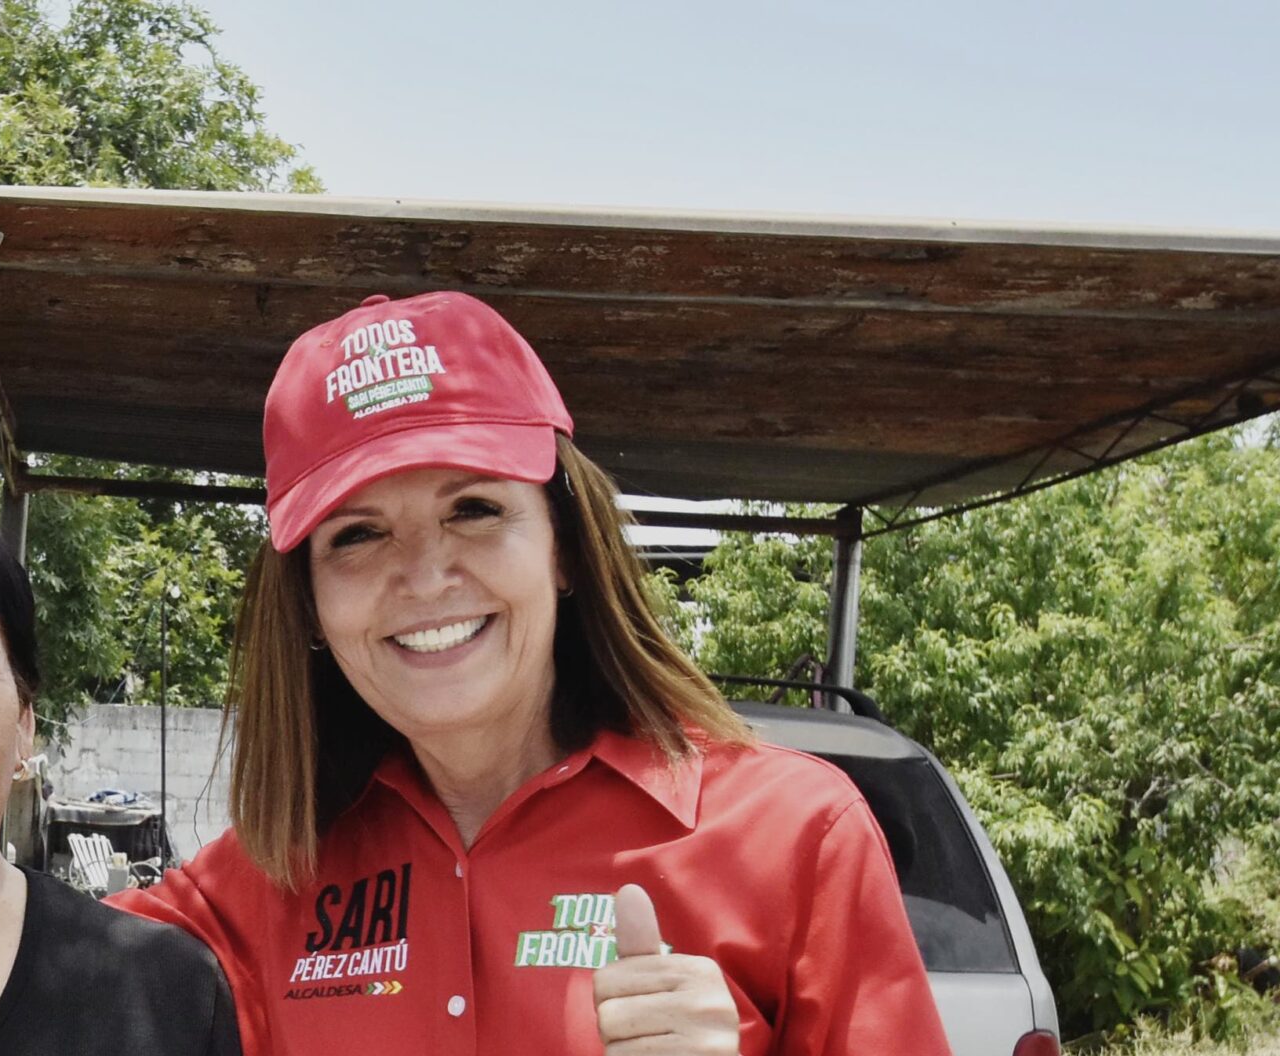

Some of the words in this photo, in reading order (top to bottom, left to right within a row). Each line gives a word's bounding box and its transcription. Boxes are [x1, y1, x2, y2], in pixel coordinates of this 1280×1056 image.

[341, 319, 417, 361] TODOS
[325, 345, 447, 404] FRONTERA
[306, 863, 412, 953] SARI
[290, 950, 348, 983] PÉREZ
[347, 938, 408, 977] CANTÚ
[284, 983, 363, 1000] ALCALDESA
